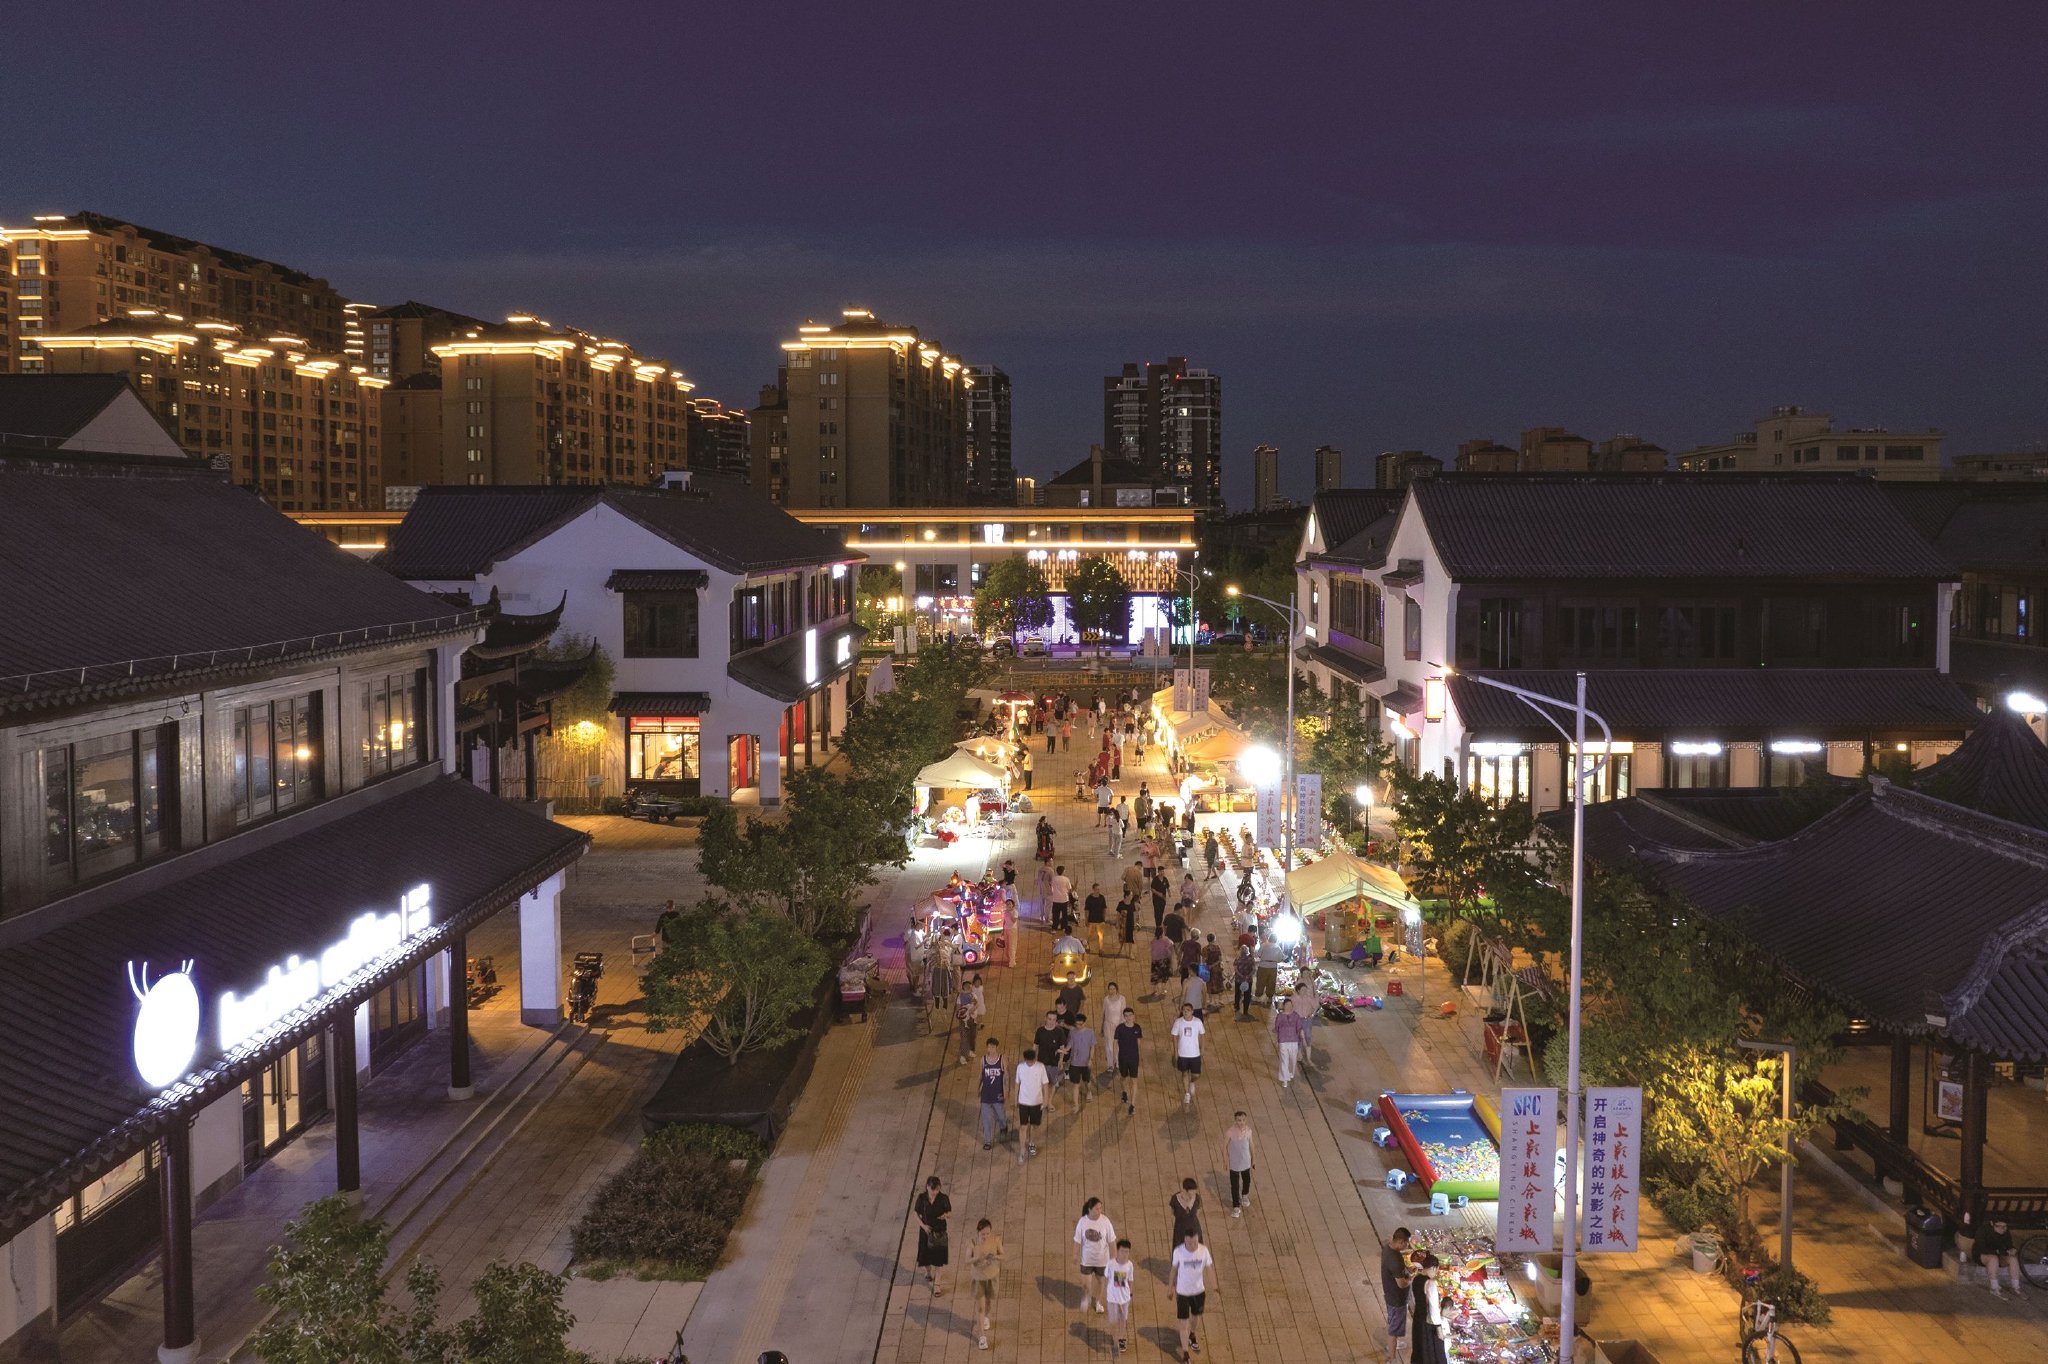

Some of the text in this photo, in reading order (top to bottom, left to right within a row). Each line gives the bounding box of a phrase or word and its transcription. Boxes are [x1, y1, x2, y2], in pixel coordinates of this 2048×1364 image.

[984, 1068, 1001, 1077] NETS
[990, 1076, 996, 1085] 7
[1513, 1095, 1541, 1116] SFC
[1508, 1120, 1519, 1242] SHANGYING CINEMA
[1519, 1120, 1542, 1245] 上影联合影城
[1589, 1098, 1608, 1245] 开启神奇的光影之旅
[1607, 1122, 1629, 1247] 上影联合影城
